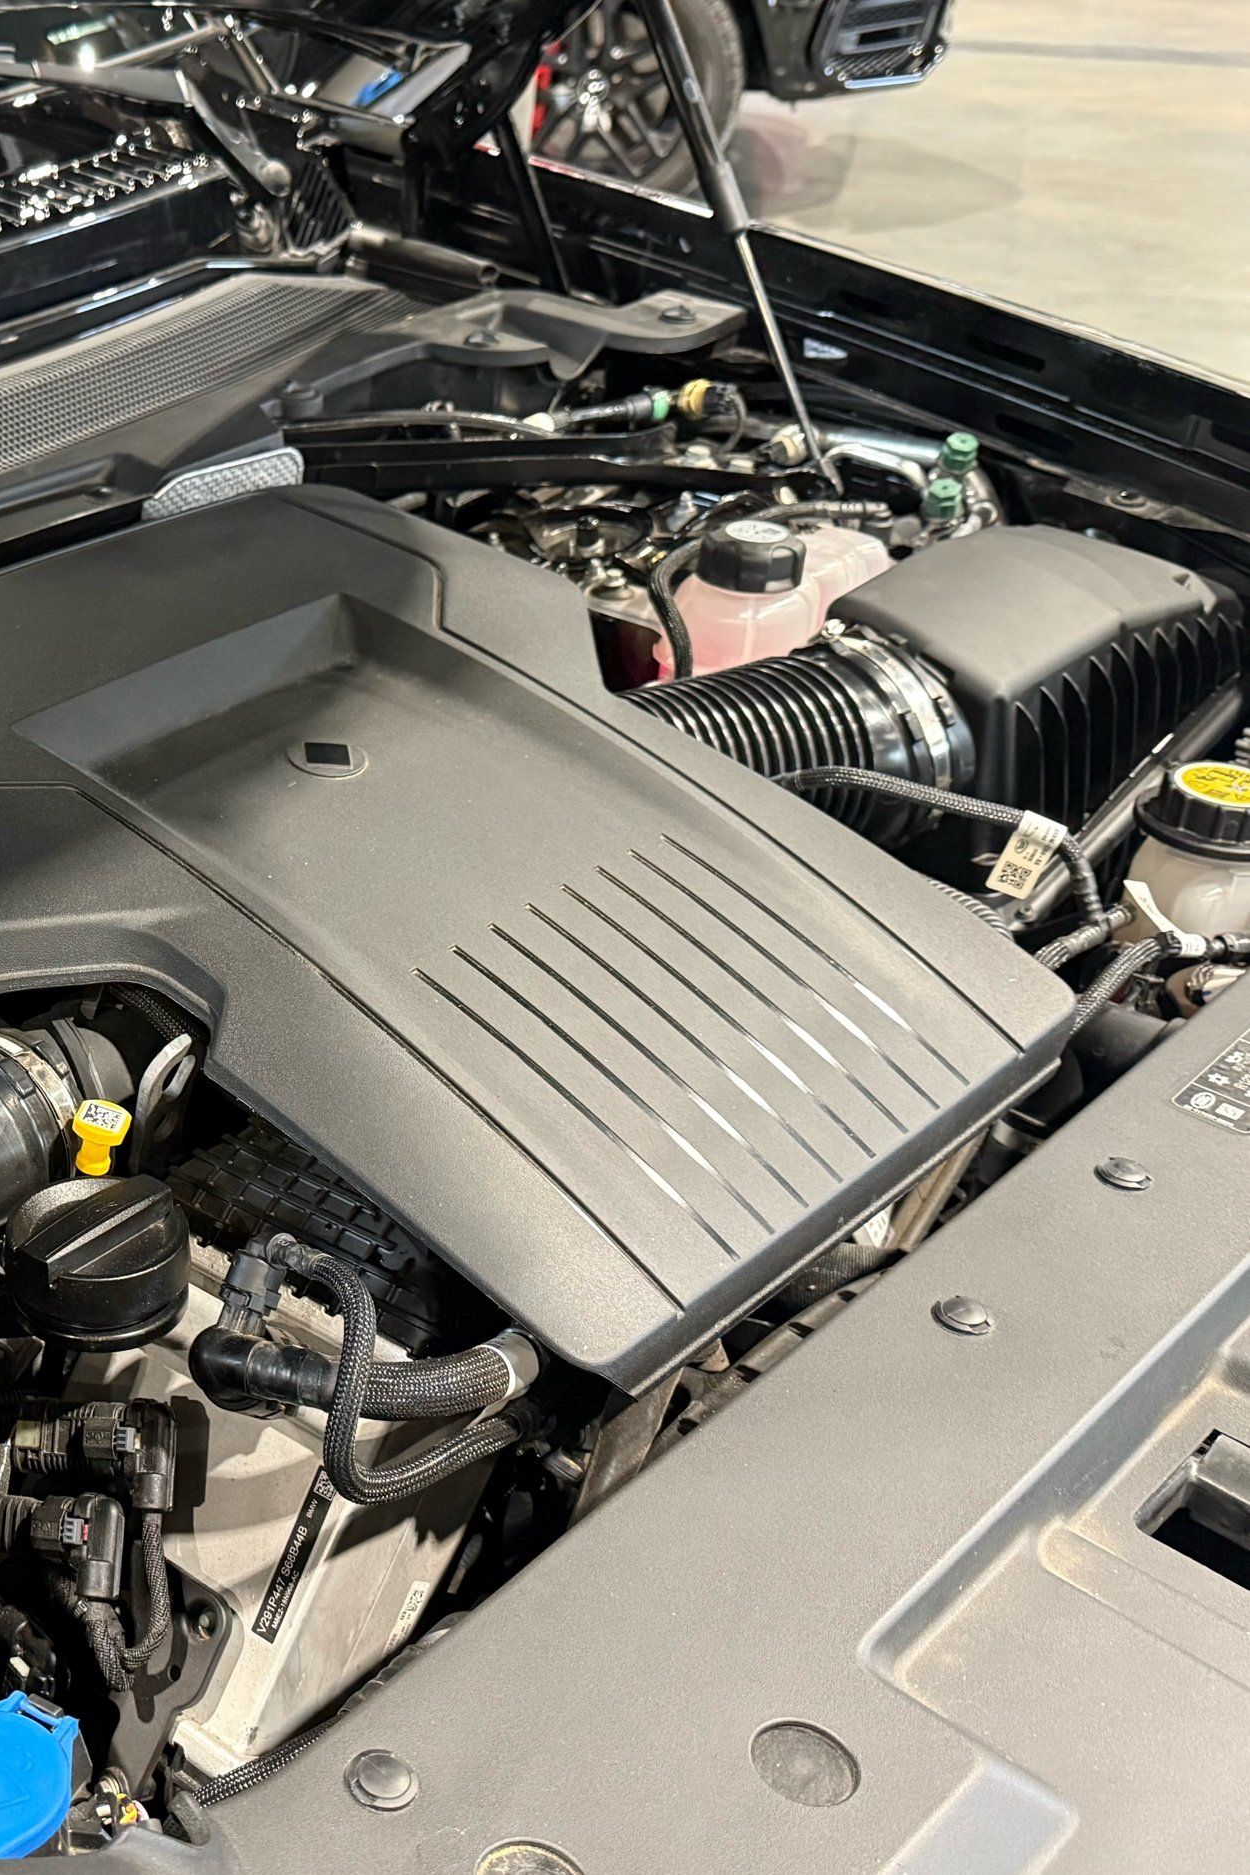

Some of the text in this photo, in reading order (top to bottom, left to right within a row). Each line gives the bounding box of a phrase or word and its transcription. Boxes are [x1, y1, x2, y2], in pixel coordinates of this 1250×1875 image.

[256, 1499, 319, 1633] V291P447 S68B44B BMW
